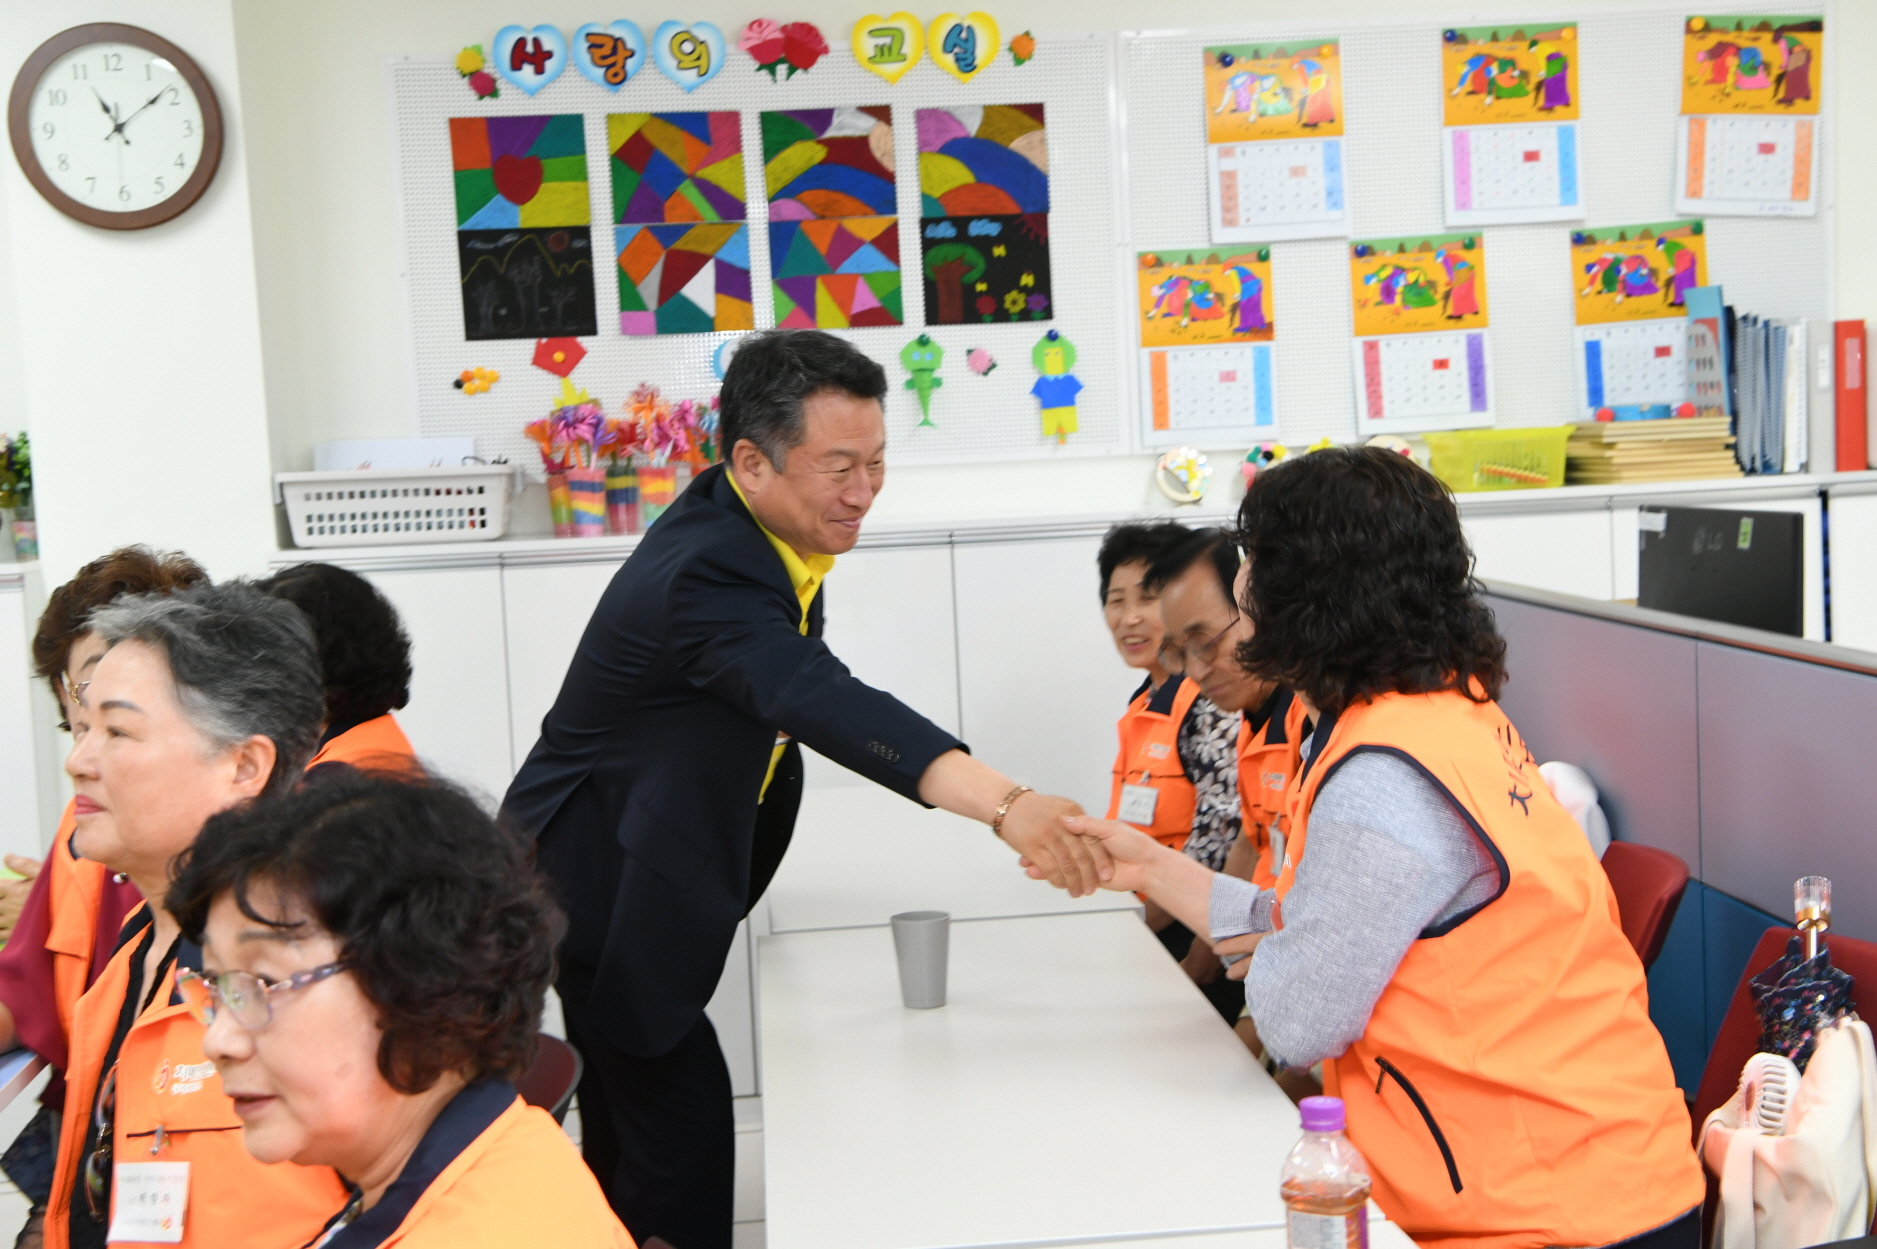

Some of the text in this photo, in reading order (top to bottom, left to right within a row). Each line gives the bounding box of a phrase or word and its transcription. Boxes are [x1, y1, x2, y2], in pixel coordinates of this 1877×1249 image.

[103, 53, 122, 71] 12
[510, 22, 978, 86] 사랑의 교실
[72, 63, 88, 79] 11
[144, 63, 152, 81] 1
[48, 88, 66, 105] 10
[167, 88, 180, 105] 2
[42, 122, 54, 139] 9
[182, 119, 193, 137] 3
[57, 153, 69, 170] 8
[173, 152, 185, 168] 4
[85, 176, 96, 193] 7
[118, 184, 130, 201] 6
[153, 176, 164, 193] 5
